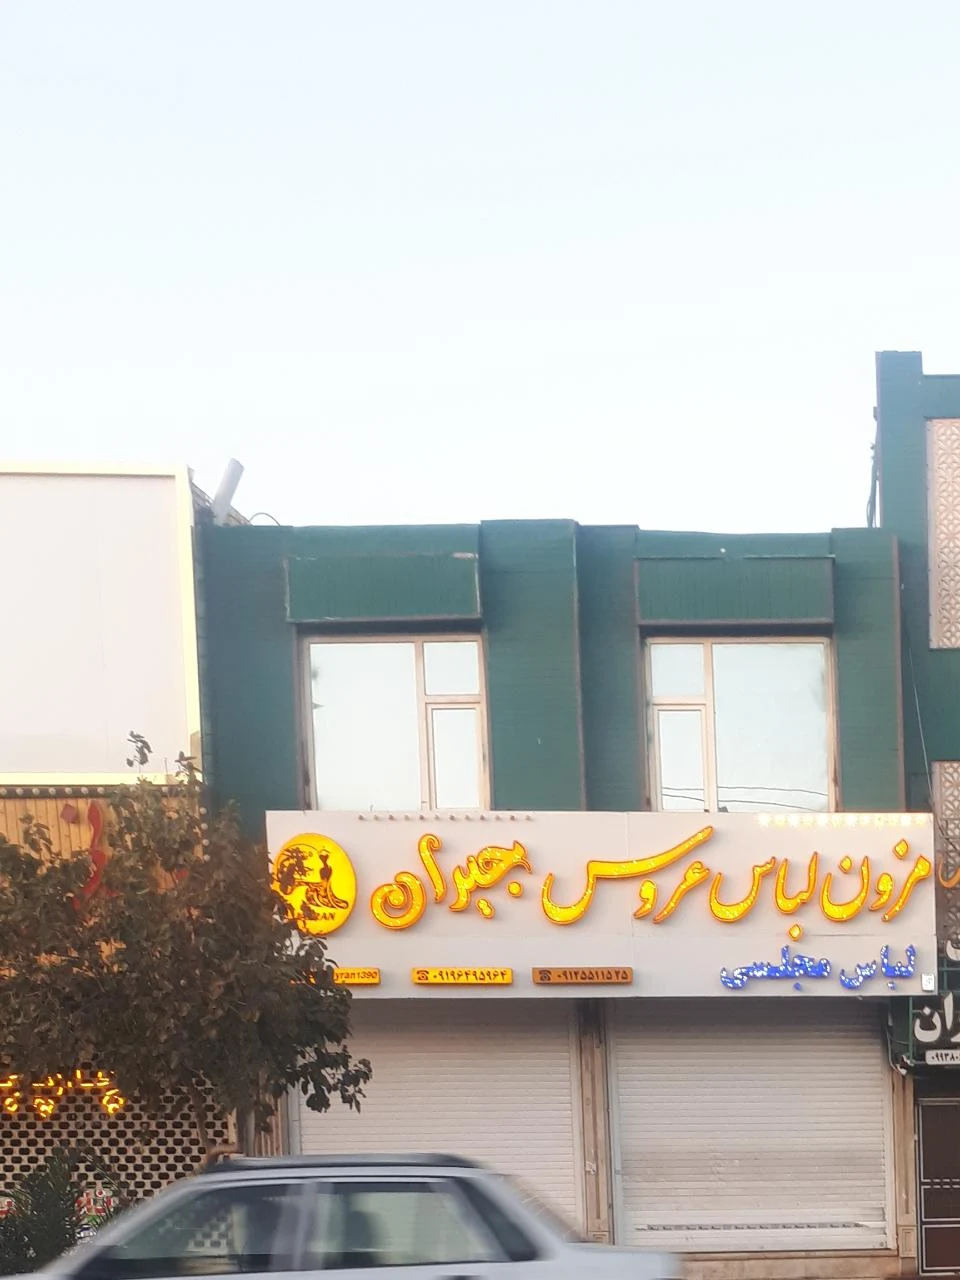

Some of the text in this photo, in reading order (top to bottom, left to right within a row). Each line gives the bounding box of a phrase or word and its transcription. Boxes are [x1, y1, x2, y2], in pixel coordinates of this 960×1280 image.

[371, 825, 932, 942] مزون لباس عروس جیران
[720, 945, 917, 993] لباس مجلسی
